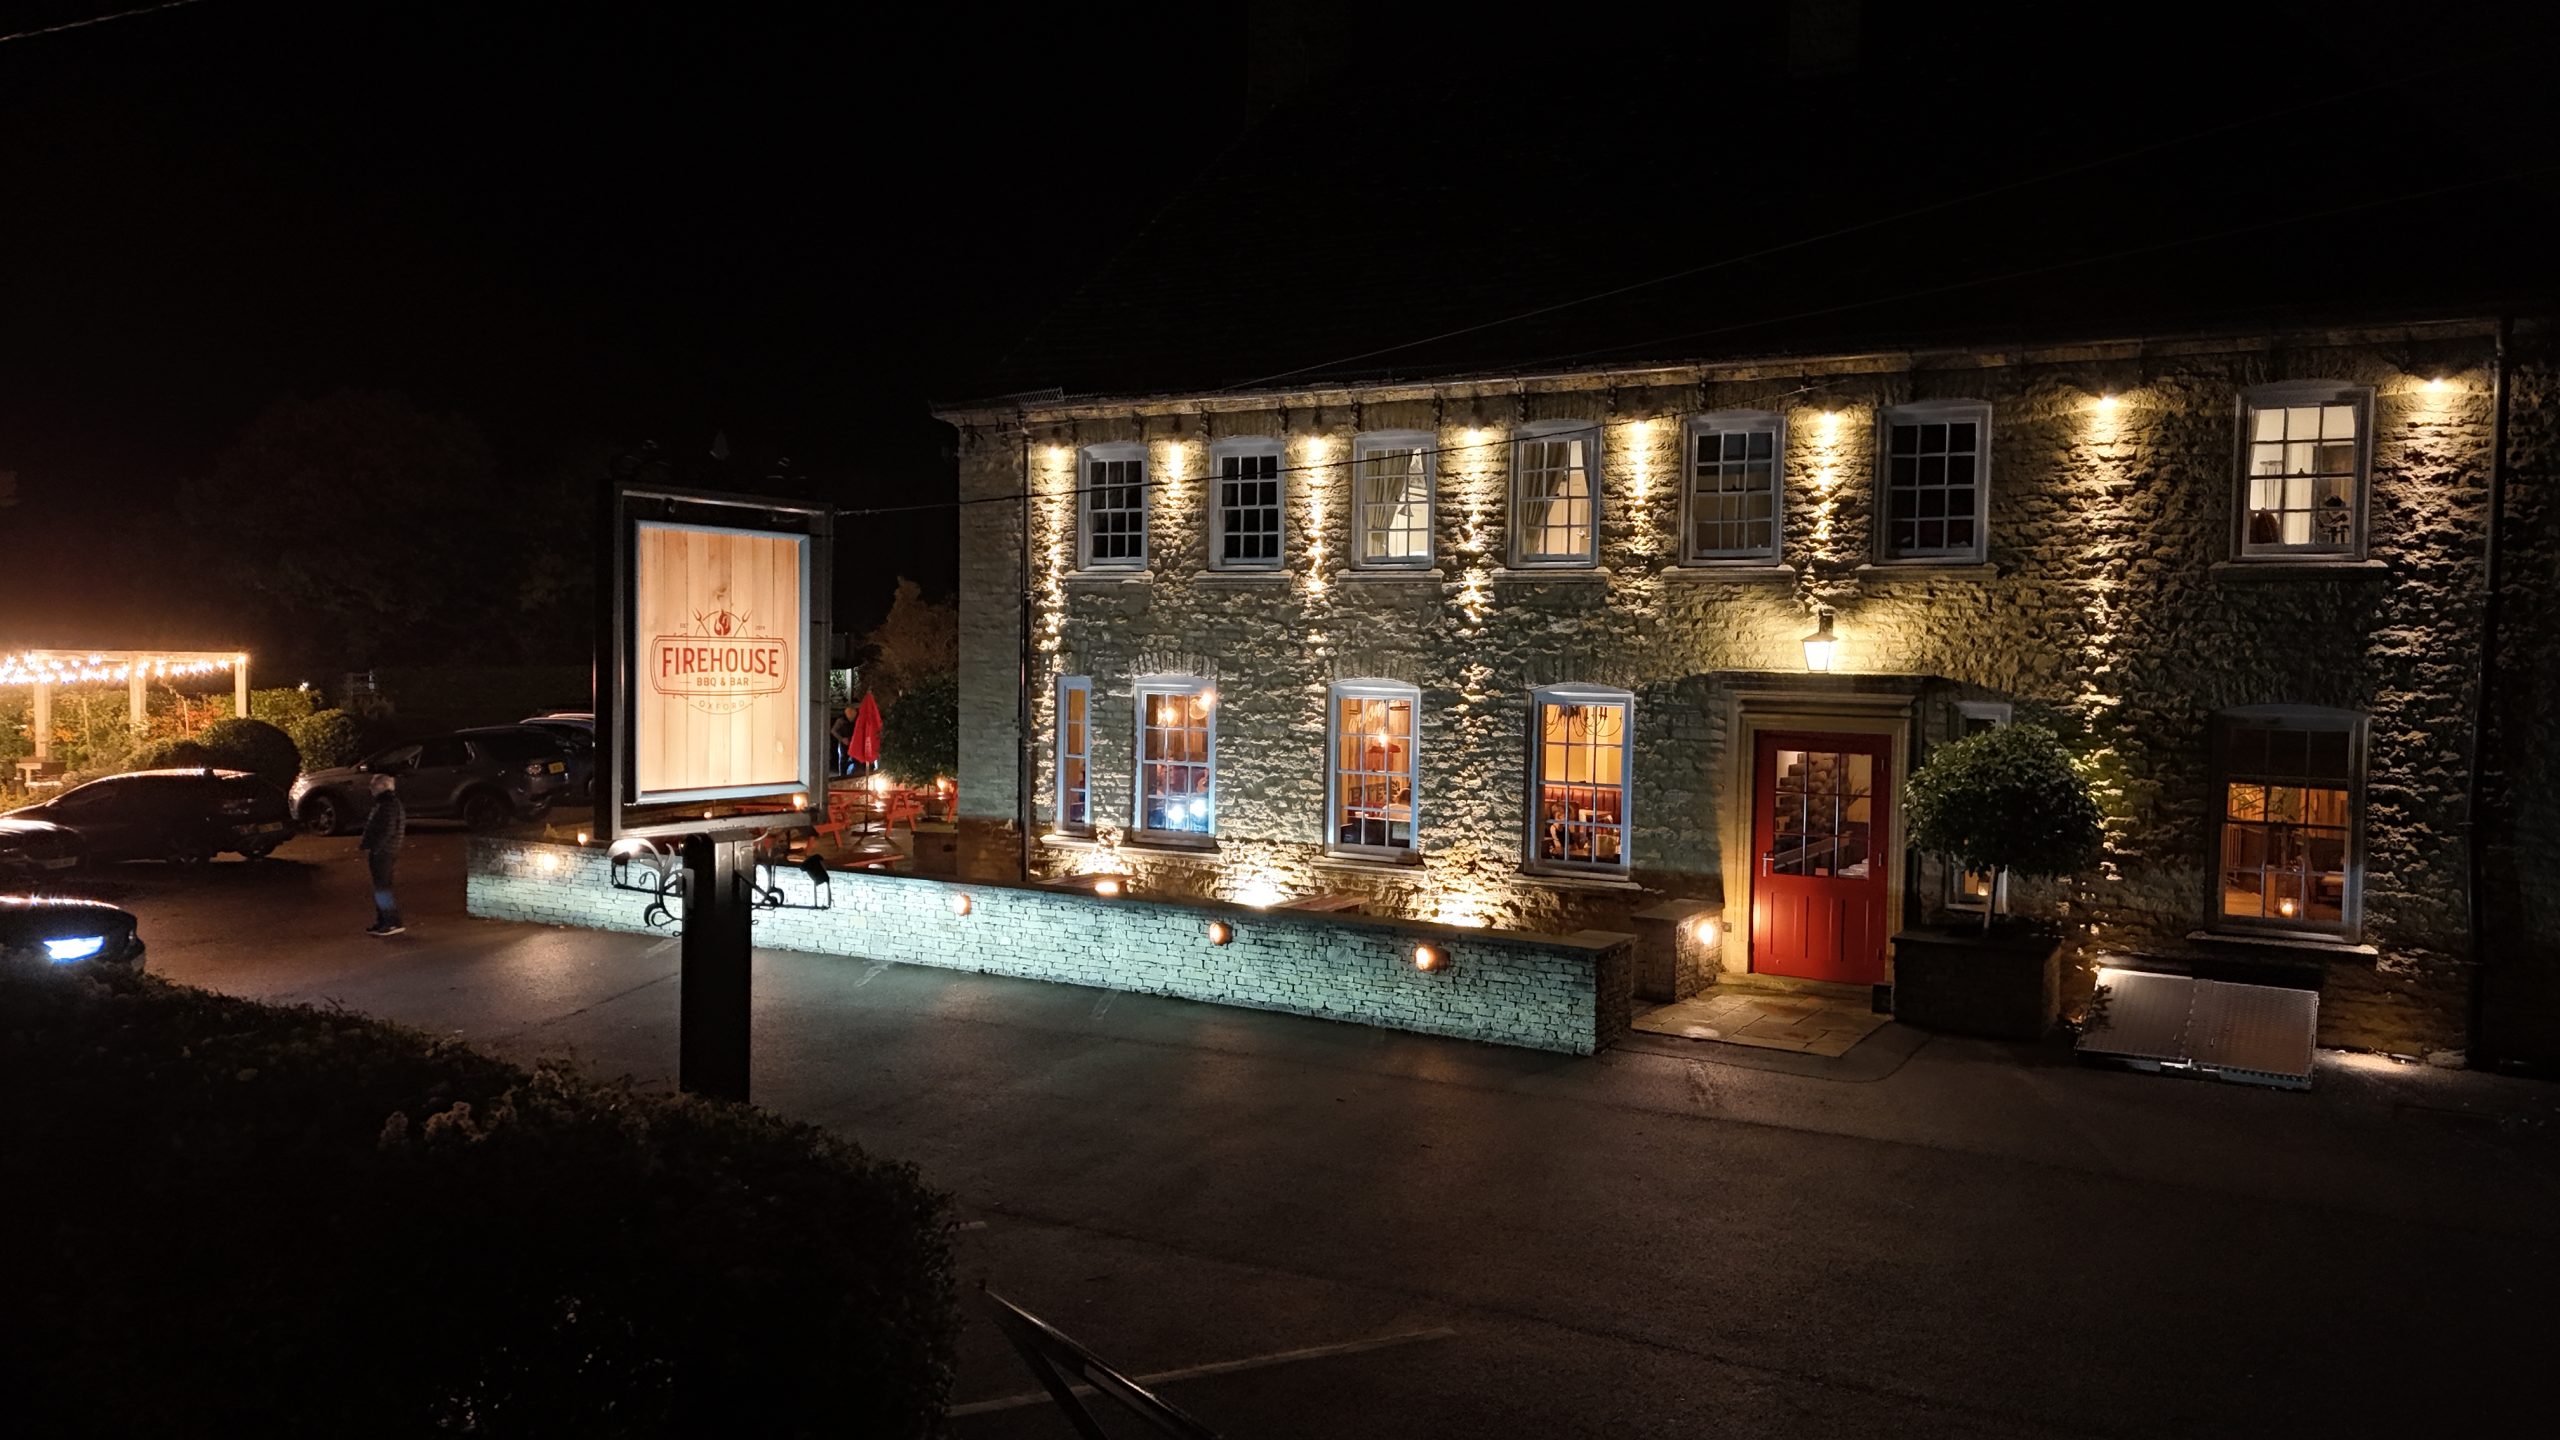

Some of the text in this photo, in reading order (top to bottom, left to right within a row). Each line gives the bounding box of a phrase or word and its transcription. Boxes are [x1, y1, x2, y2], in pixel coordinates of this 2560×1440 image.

[662, 647, 779, 678] FIREHOUSE
[696, 677, 749, 687] BBQ & BAR
[699, 700, 745, 711] OXFORD
